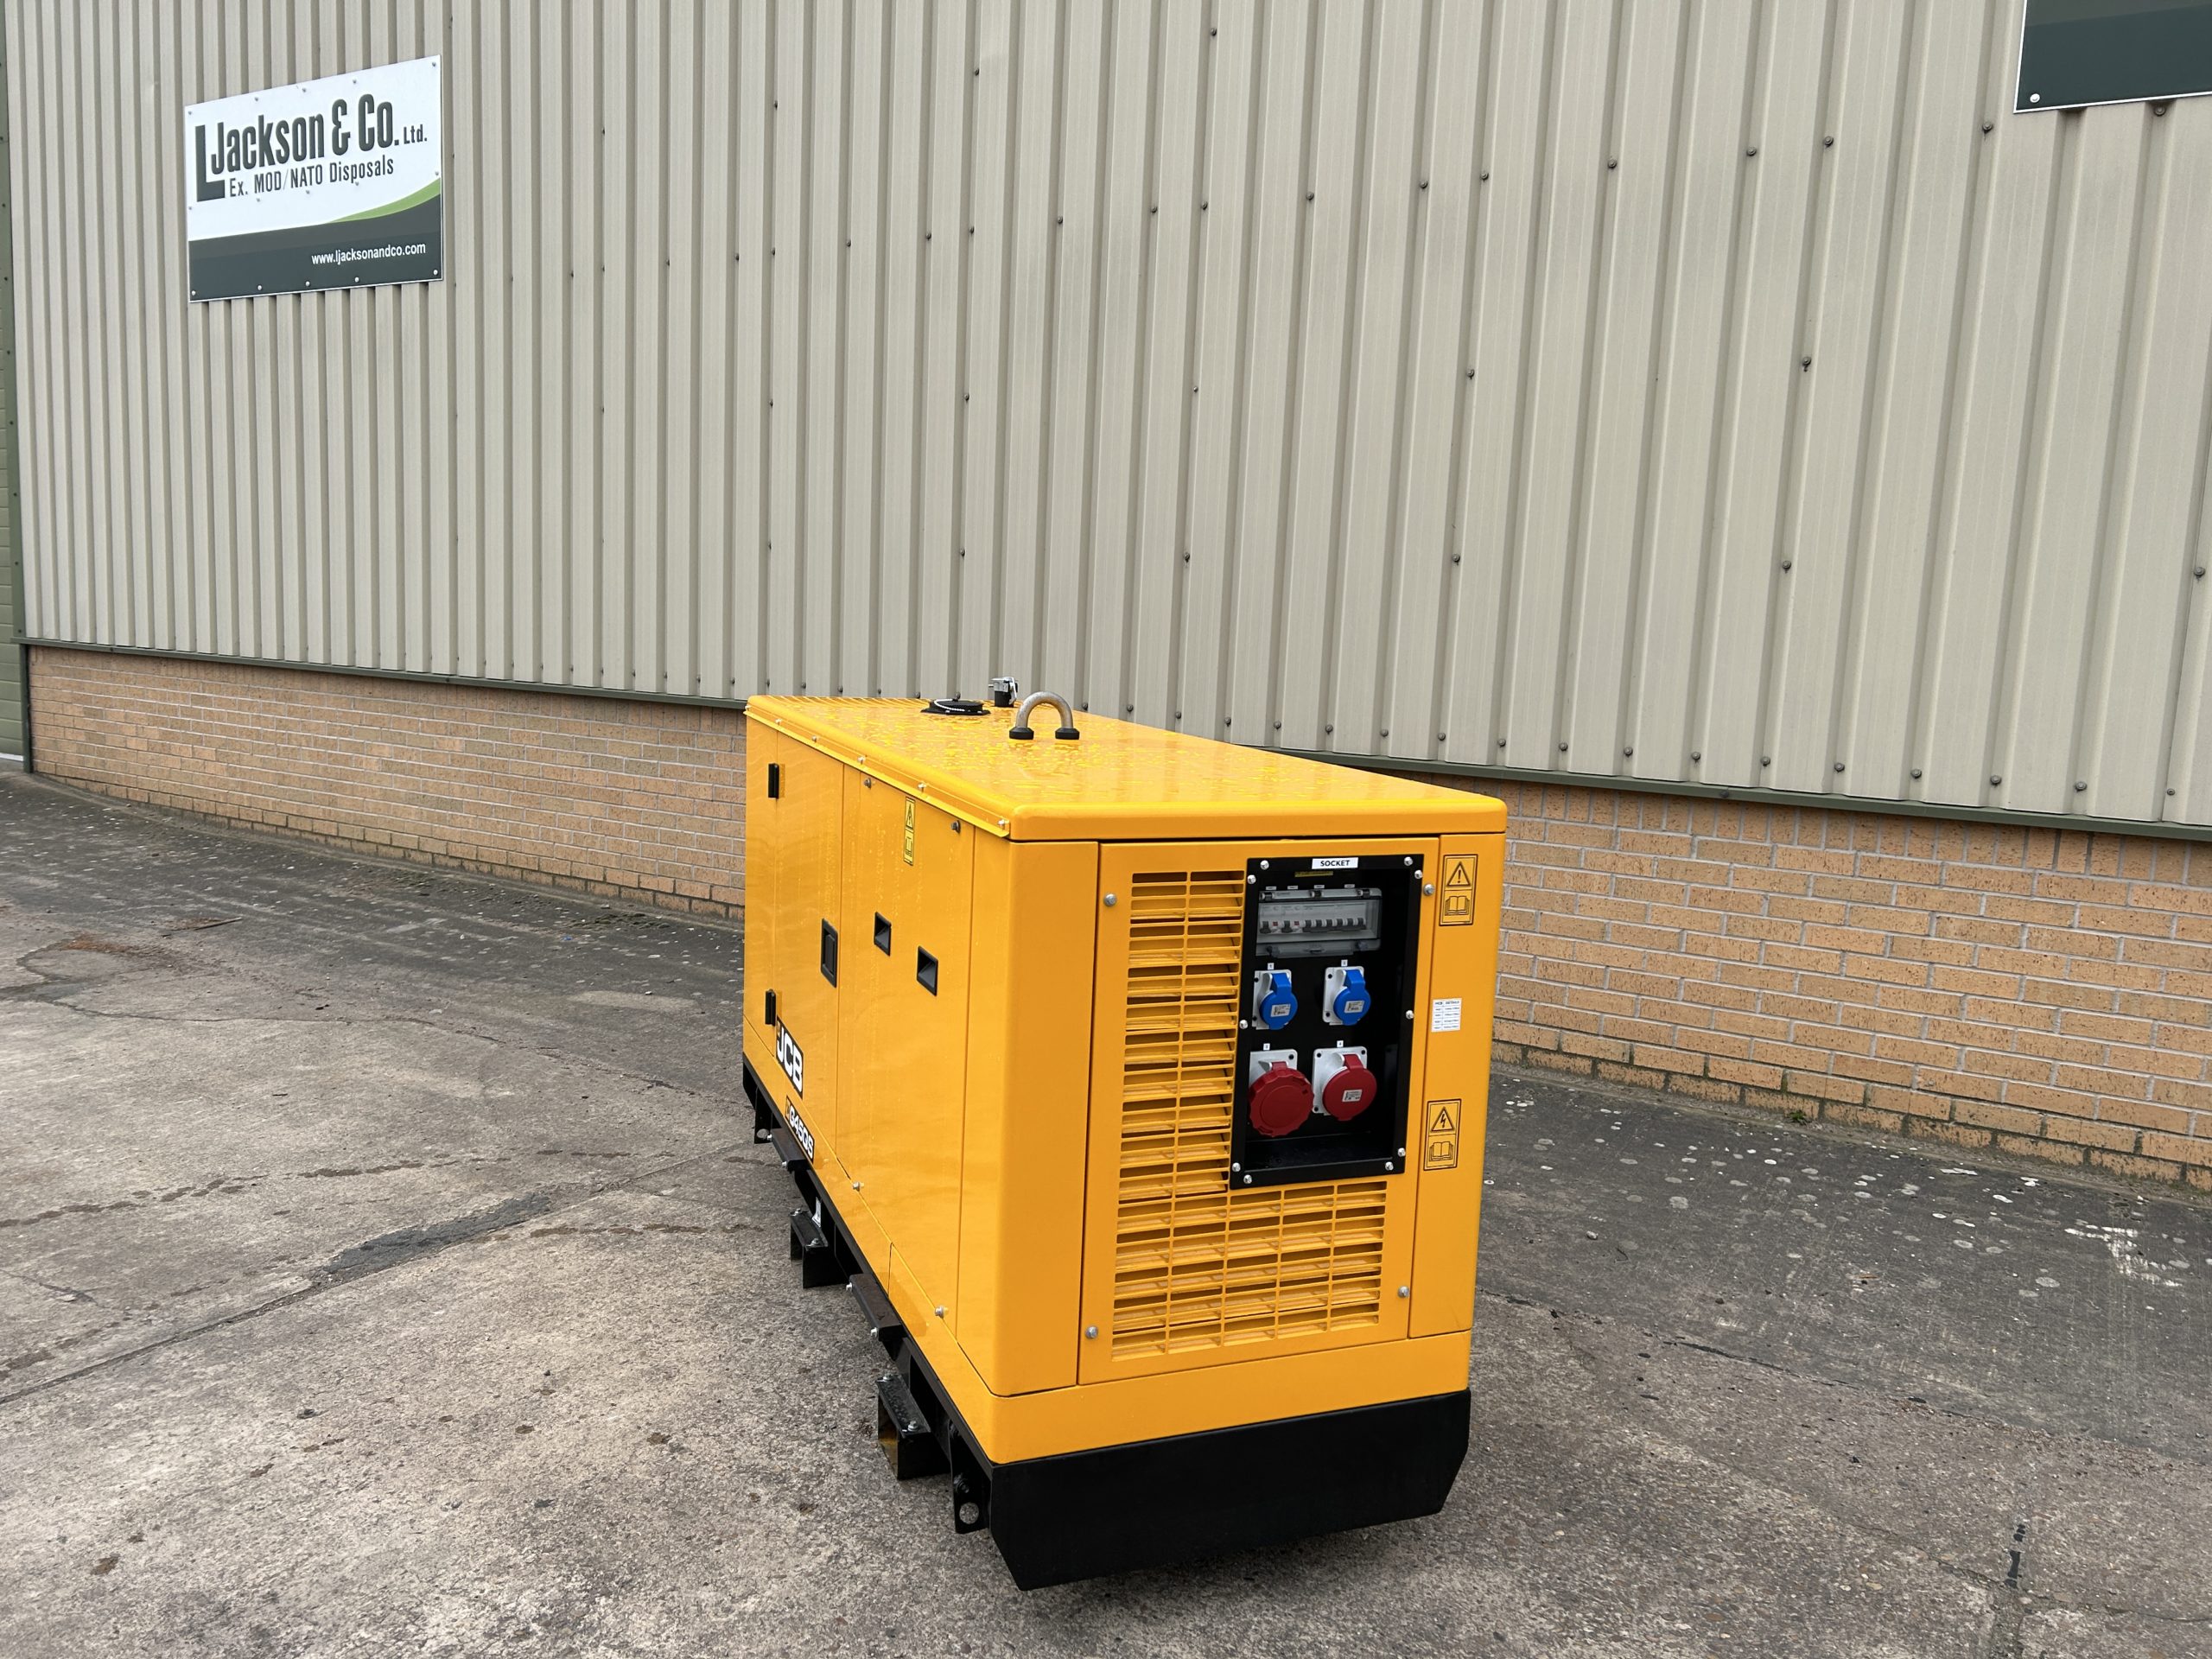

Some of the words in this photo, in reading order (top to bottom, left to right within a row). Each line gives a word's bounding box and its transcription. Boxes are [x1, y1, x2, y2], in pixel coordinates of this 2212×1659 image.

[332, 99, 351, 156] &
[359, 93, 399, 151] Co.
[404, 124, 428, 144] Ltd.
[230, 177, 248, 197] Ex.
[330, 155, 394, 183] Disposals
[311, 242, 426, 265] www.ljacksonandco.com
[777, 1027, 803, 1093] JCB
